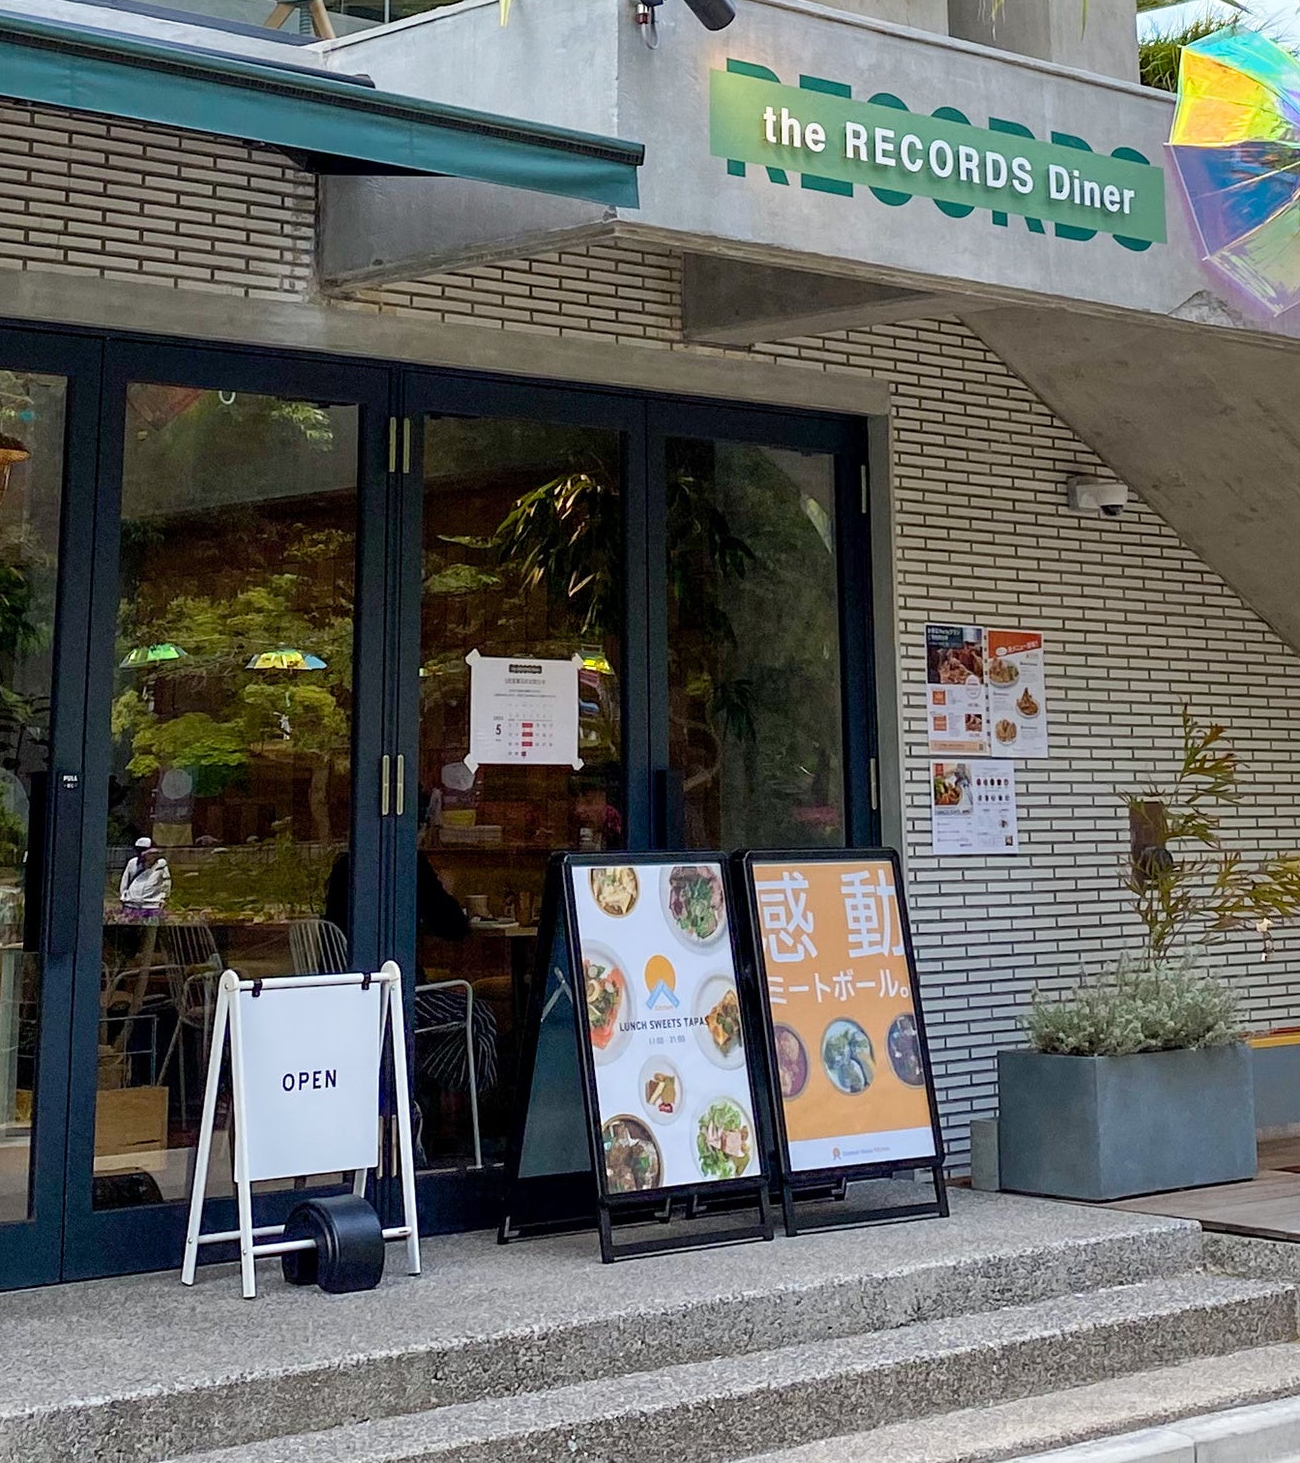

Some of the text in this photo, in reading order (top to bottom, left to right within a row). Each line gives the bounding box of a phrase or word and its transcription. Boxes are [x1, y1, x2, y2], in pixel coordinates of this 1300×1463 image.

[763, 106, 1136, 214] the RECORDS Diner
[495, 724, 502, 735] 5
[755, 869, 906, 963] 感動
[619, 1020, 648, 1032] LUNCH
[650, 1018, 682, 1030] SWEETS
[282, 1069, 337, 1092] OPEN
